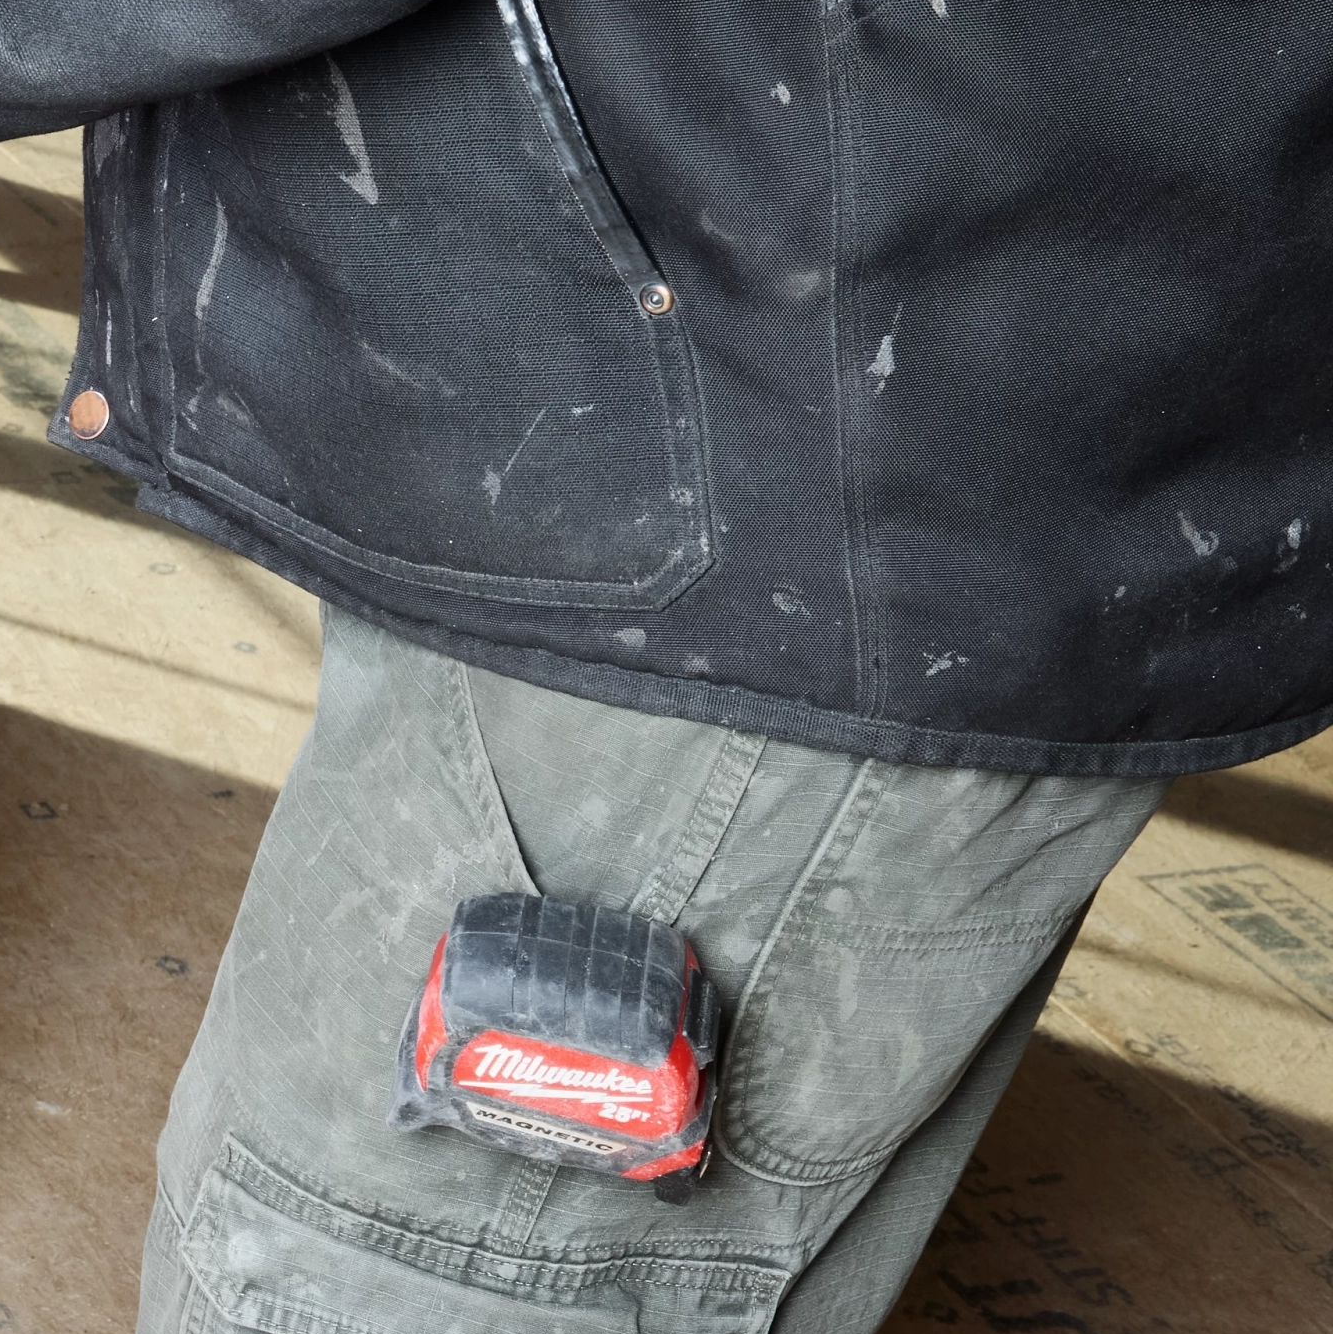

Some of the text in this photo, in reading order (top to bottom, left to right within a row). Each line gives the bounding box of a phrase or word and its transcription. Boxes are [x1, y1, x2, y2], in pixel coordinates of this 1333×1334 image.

[474, 1043, 653, 1095] Milwaukee
[475, 1108, 614, 1153] MAGNETIC
[989, 1210, 1134, 1312] STIFF
